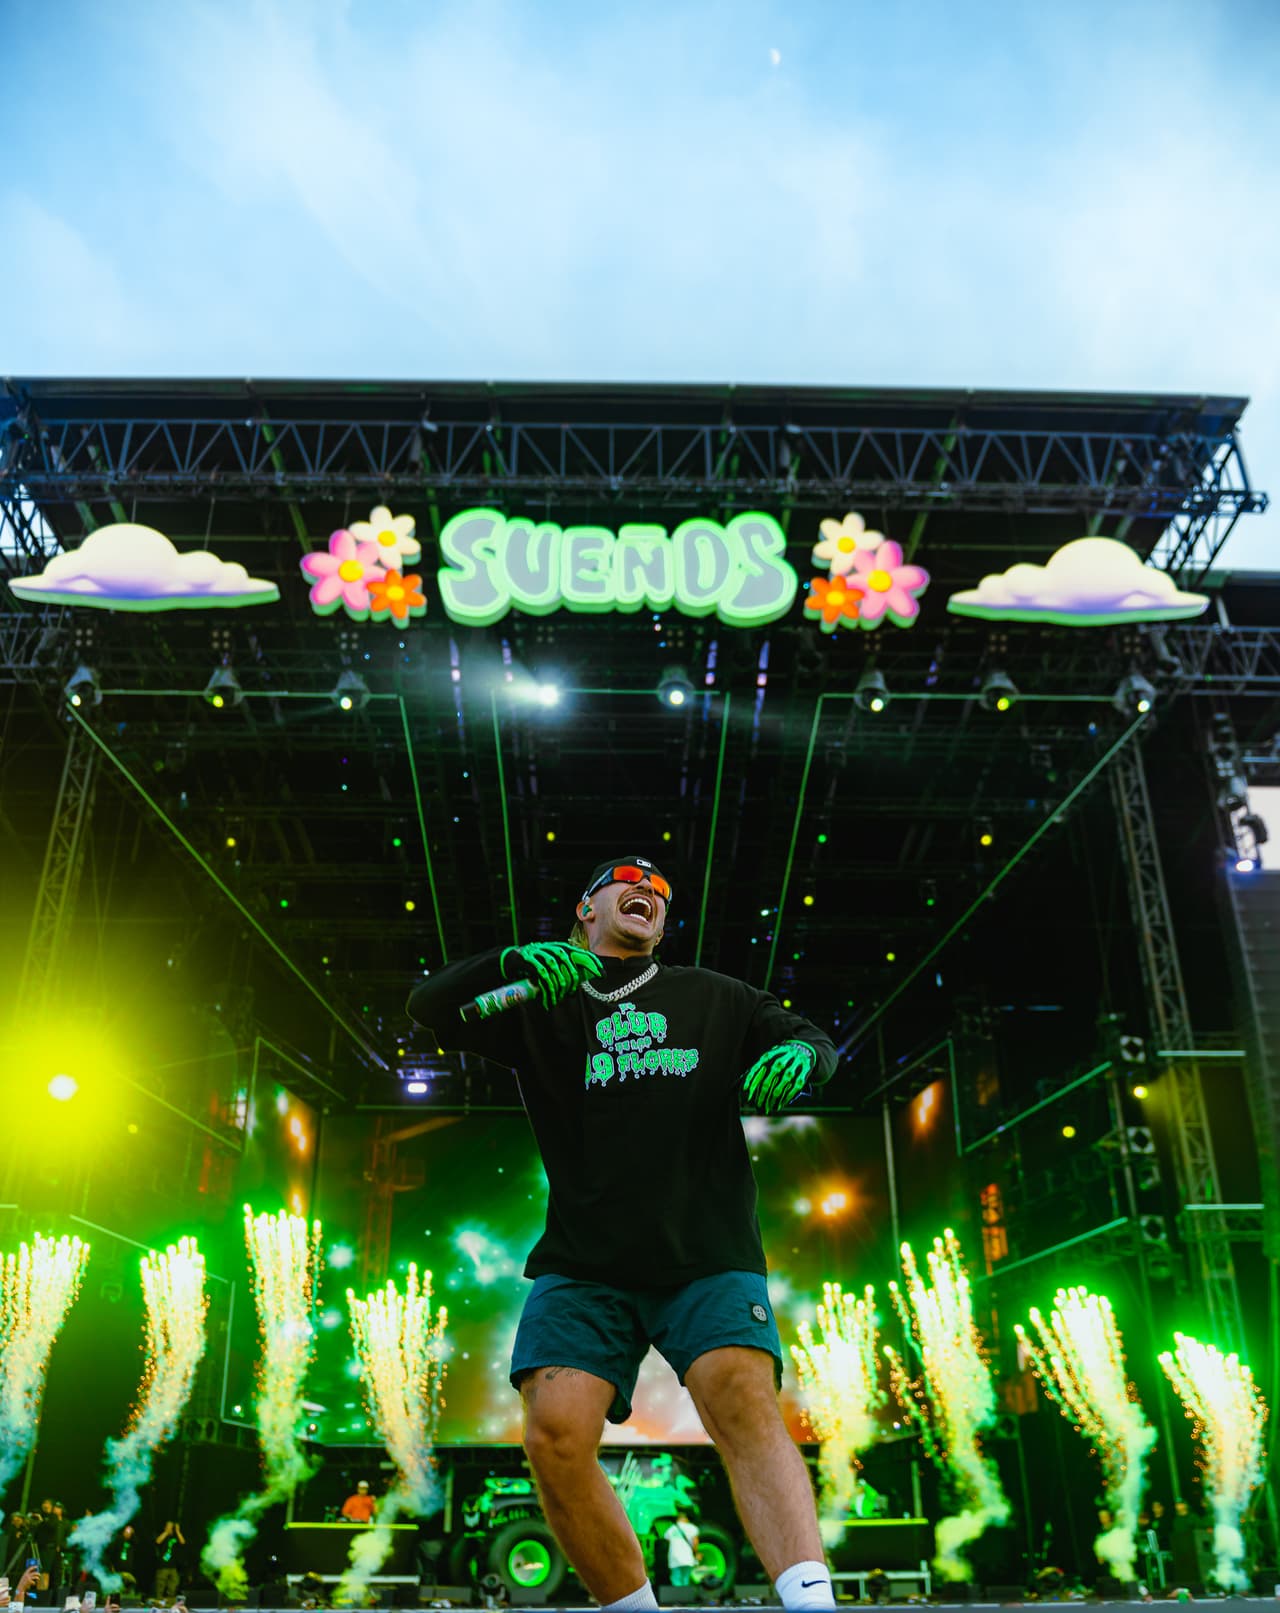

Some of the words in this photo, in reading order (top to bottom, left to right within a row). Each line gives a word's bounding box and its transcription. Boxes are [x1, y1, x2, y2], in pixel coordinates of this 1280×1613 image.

[438, 508, 798, 626] SUEÑOS
[595, 1010, 668, 1052] CLUB
[617, 1048, 699, 1082] FLORES
